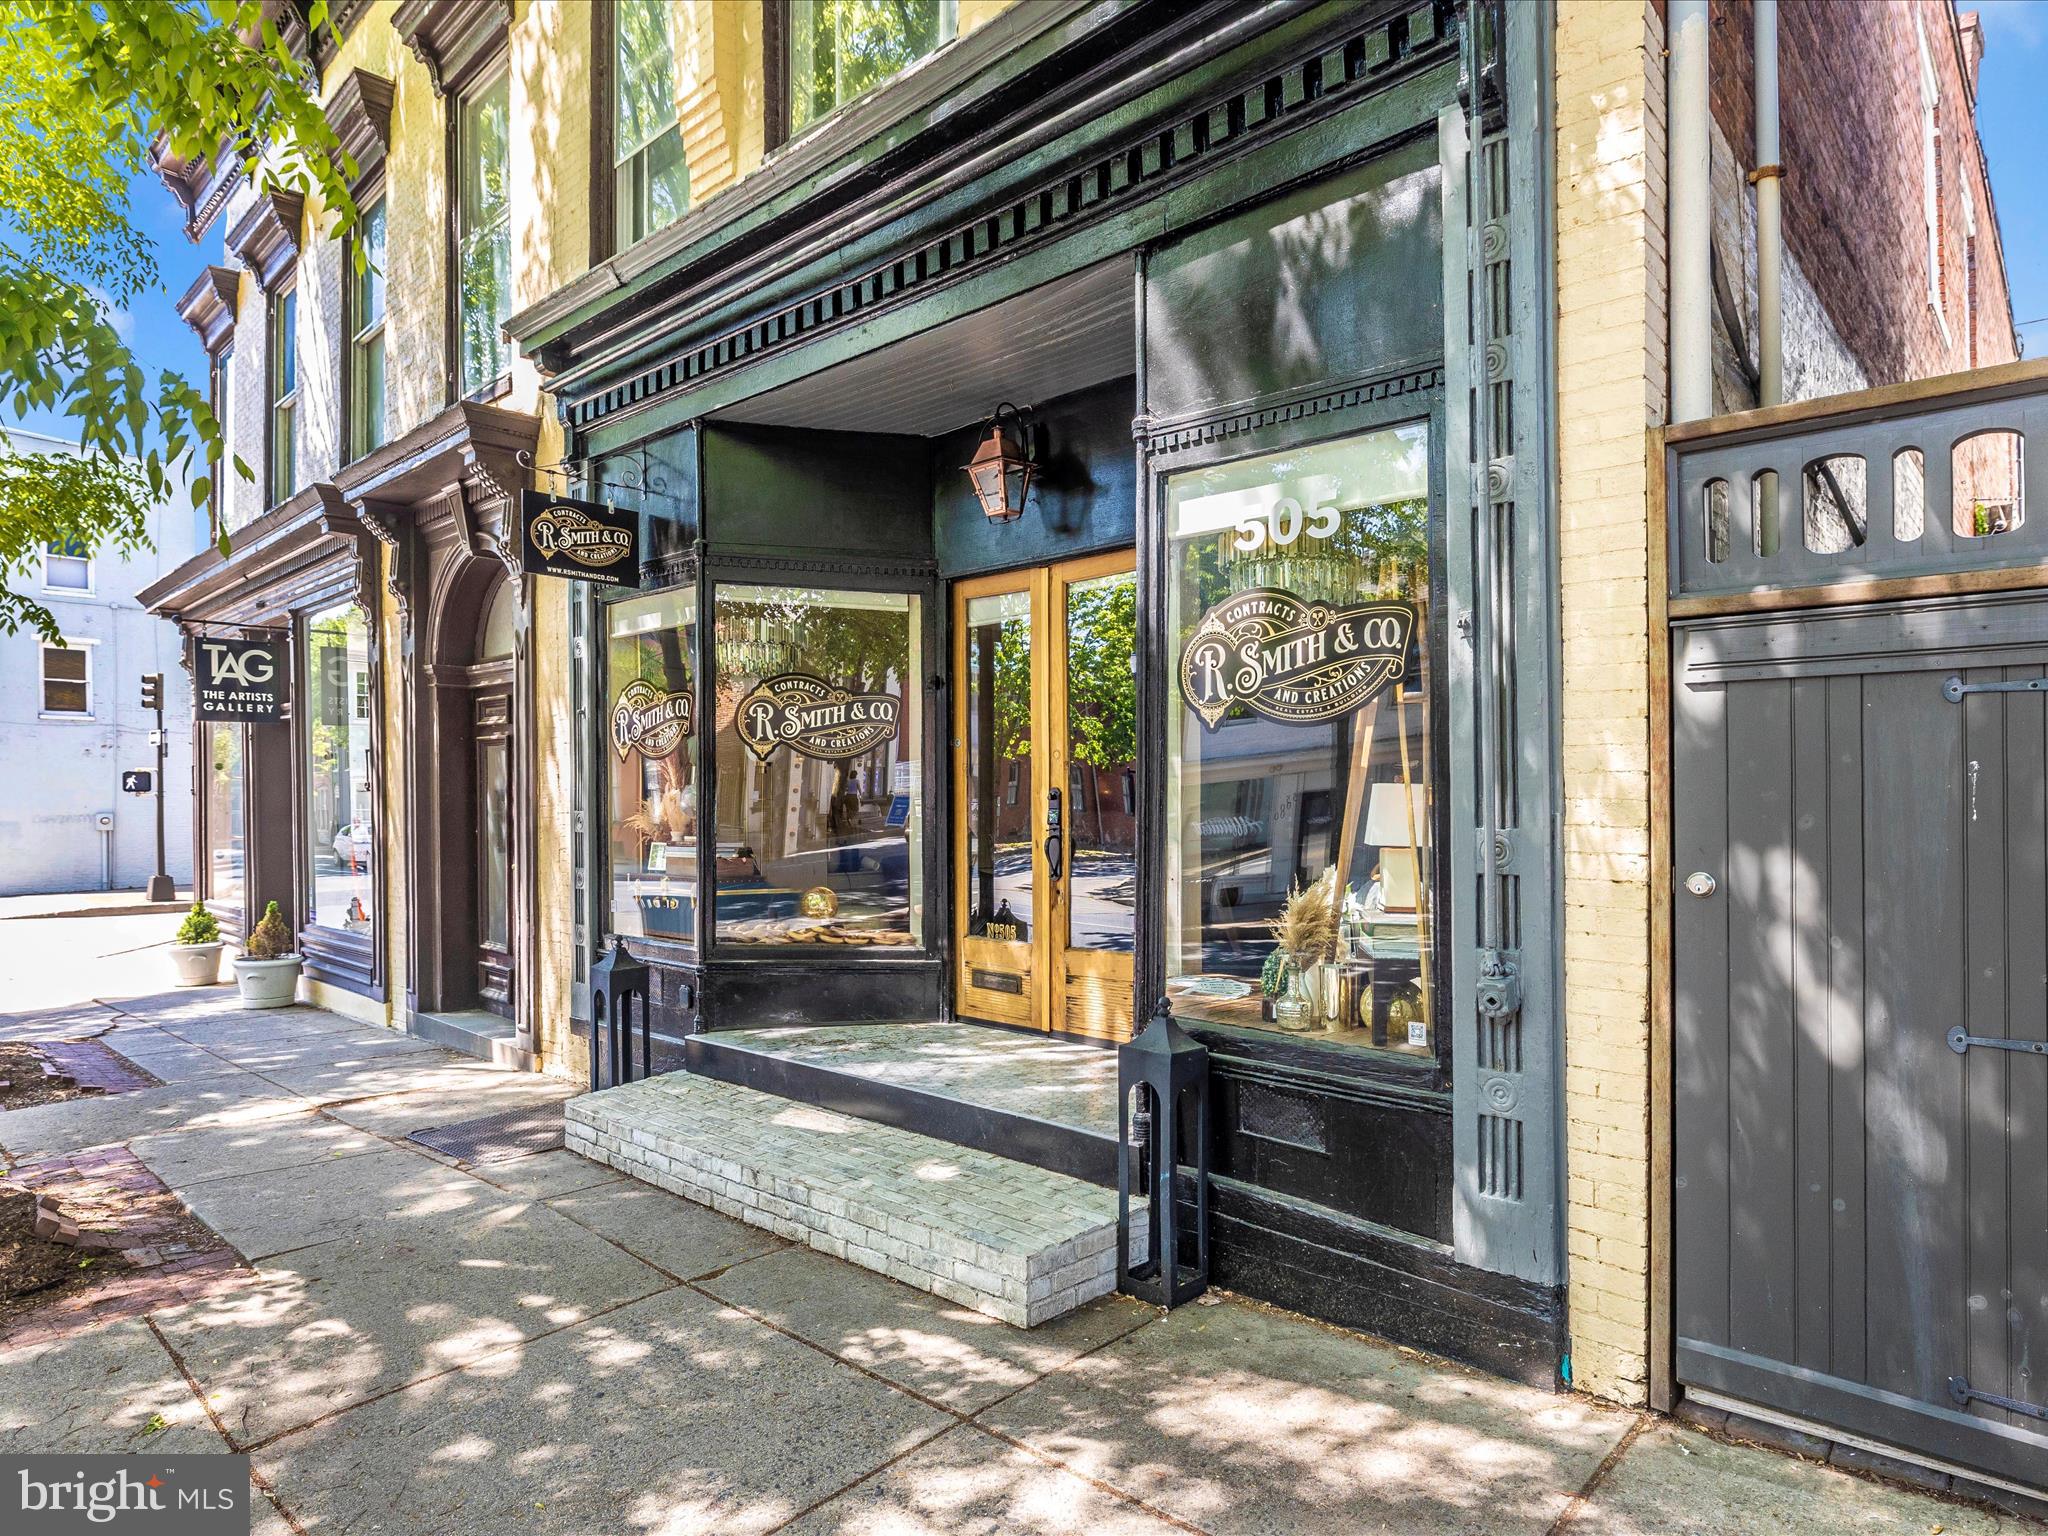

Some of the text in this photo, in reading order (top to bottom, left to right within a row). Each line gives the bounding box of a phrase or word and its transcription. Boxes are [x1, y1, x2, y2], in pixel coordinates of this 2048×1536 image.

[553, 510, 587, 524] CONTRACTS
[1233, 489, 1341, 551] 505
[602, 530, 612, 543] &
[576, 547, 617, 559] AND CREATIONS
[546, 566, 619, 582] WWW.RSMITHANDCO.COM
[1226, 601, 1297, 622] CONTRACTS
[1334, 623, 1359, 654] &
[202, 643, 274, 687] TAG
[774, 680, 826, 697] CONTRACTS
[1274, 661, 1371, 704] AND CREATIONS
[203, 690, 274, 702] THE ARTISTS
[627, 685, 654, 699] CONTRACTS
[203, 702, 273, 713] GALLERY
[665, 701, 675, 719] &
[850, 702, 866, 720] &
[1275, 705, 1292, 714] REAL
[645, 723, 679, 747] AND CREATIONS
[809, 726, 875, 748] AND CREATIONS
